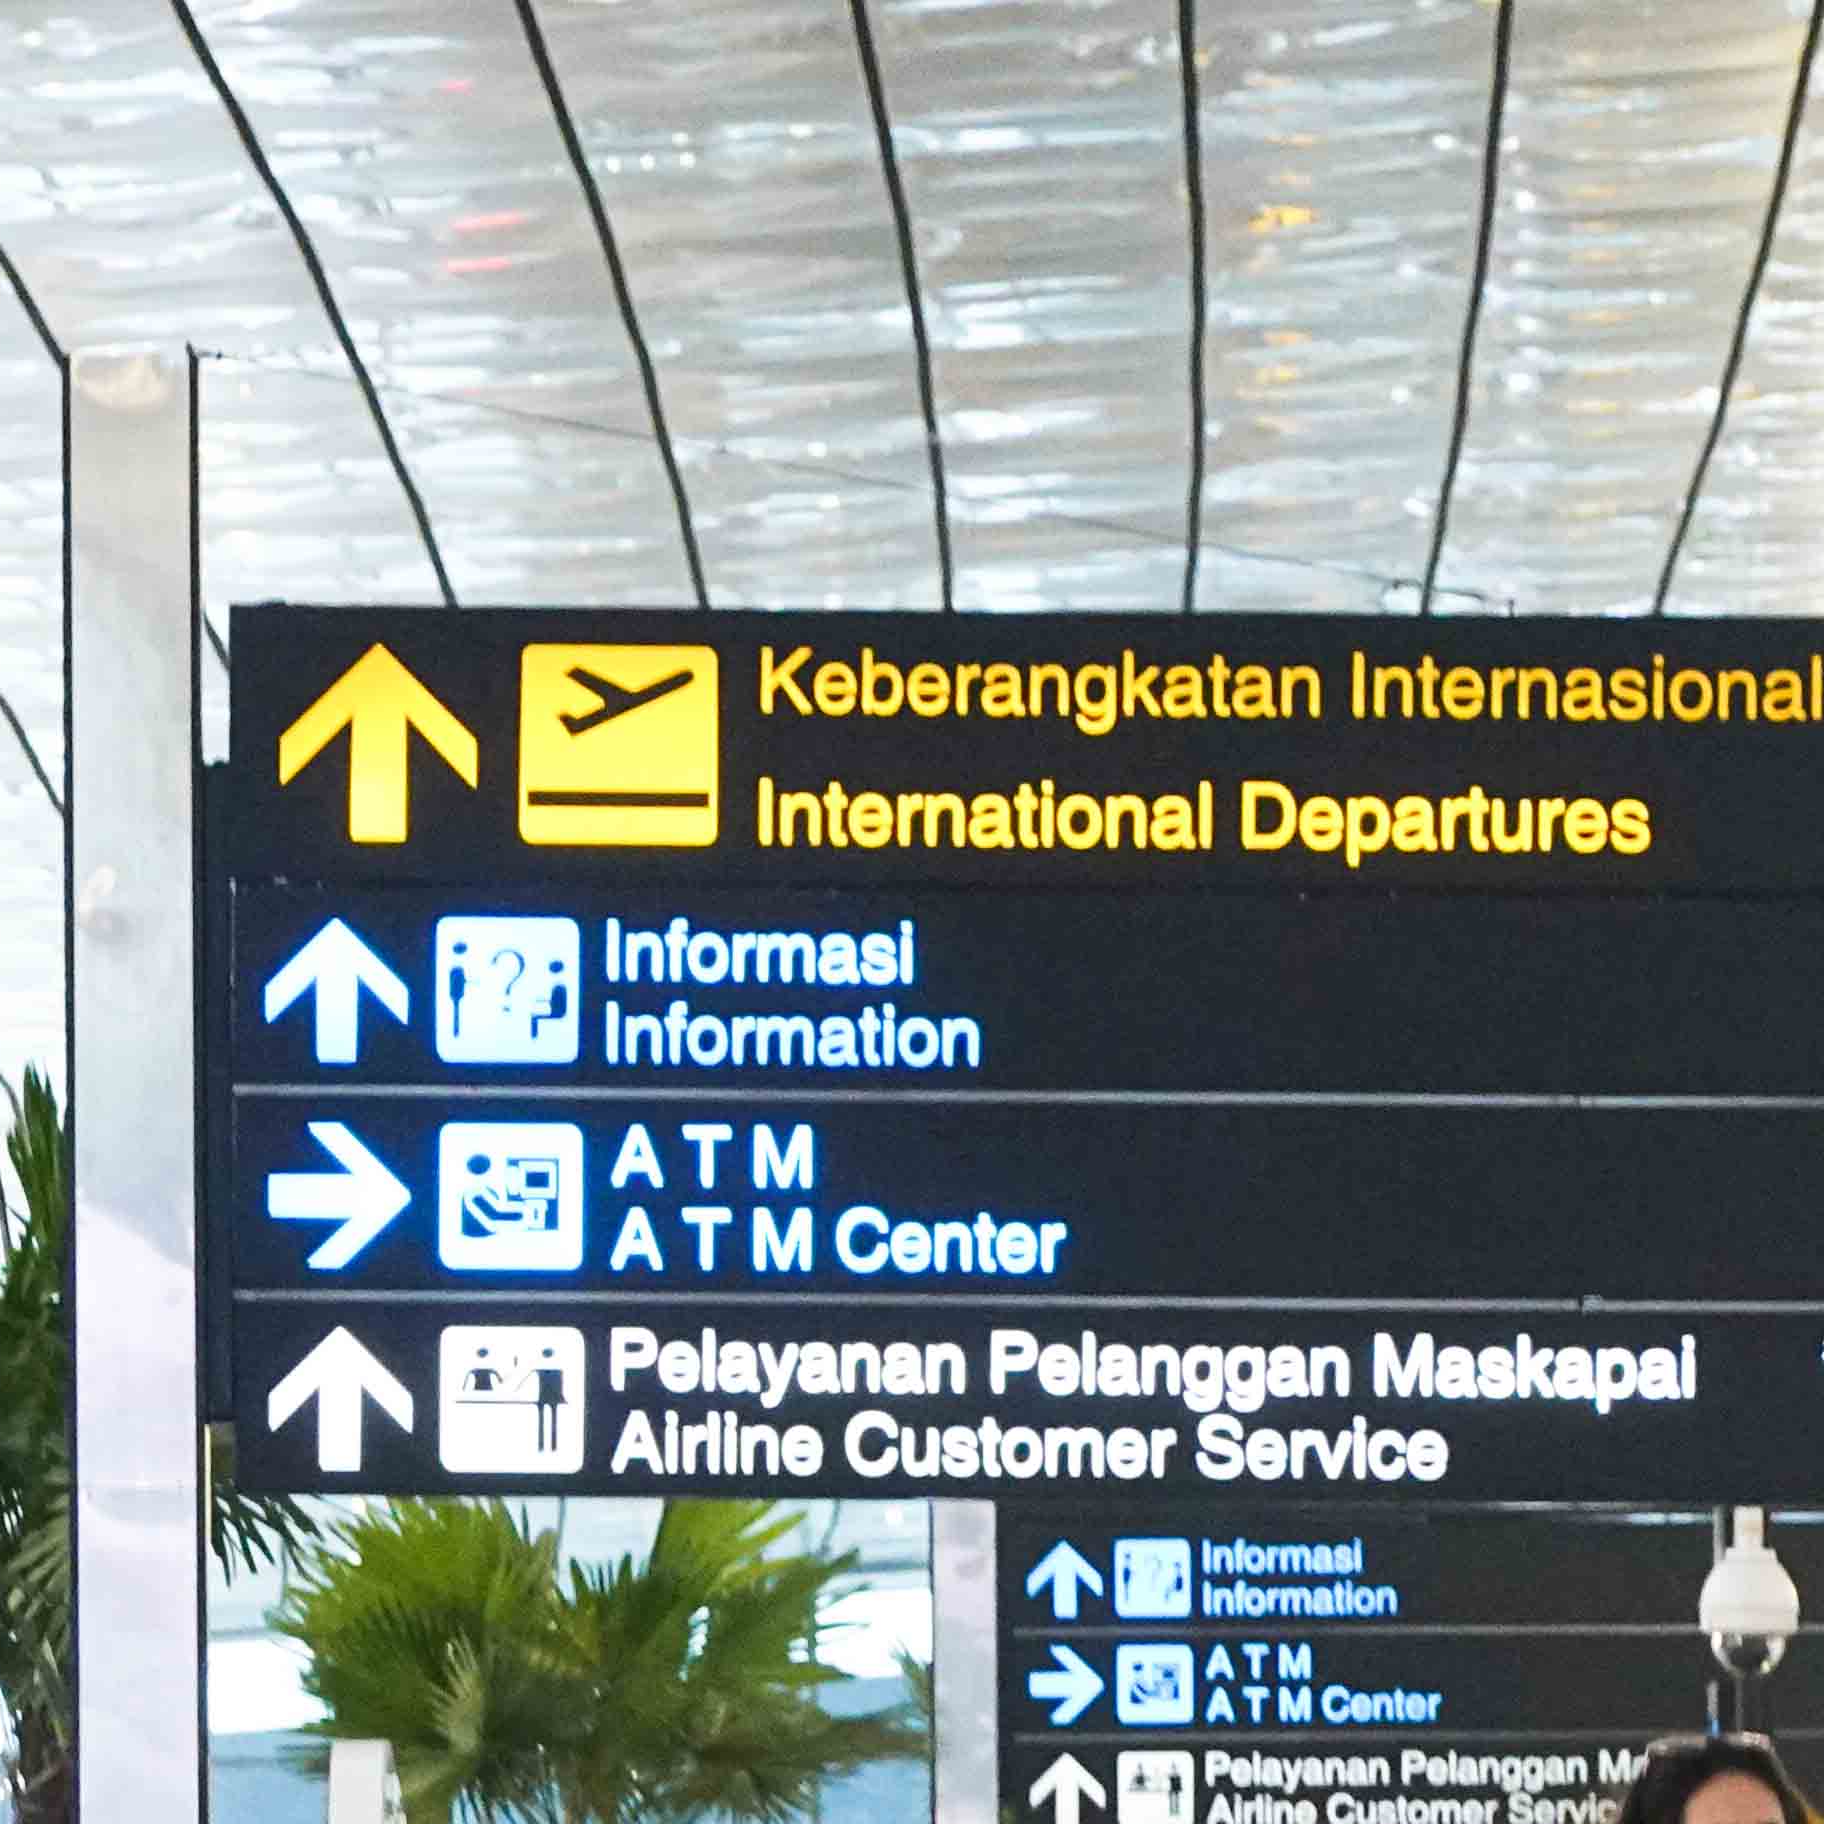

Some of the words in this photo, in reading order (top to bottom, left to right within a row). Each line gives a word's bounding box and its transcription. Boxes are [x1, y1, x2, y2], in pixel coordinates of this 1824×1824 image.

[760, 647, 1320, 735] Keberangkatan
[1352, 651, 1822, 721] Internasional
[758, 777, 1212, 850] International
[1242, 781, 1651, 867] Departures
[603, 917, 914, 986] Informasi
[603, 1003, 981, 1068] Information
[832, 1205, 1067, 1277] Center
[610, 1327, 966, 1407] Pelayanan
[989, 1330, 1351, 1413] Pelanggan
[1373, 1333, 1696, 1414] Maskapai
[611, 1410, 824, 1476] Airline
[844, 1410, 1177, 1479] Customer
[1195, 1413, 1448, 1481] Service
[1201, 1537, 1363, 1575] Informasi
[1201, 1579, 1397, 1617] Information
[1320, 1685, 1442, 1724] Center
[1205, 1751, 1390, 1793] Pelayanan
[1401, 1750, 1588, 1793] Pelanggan
